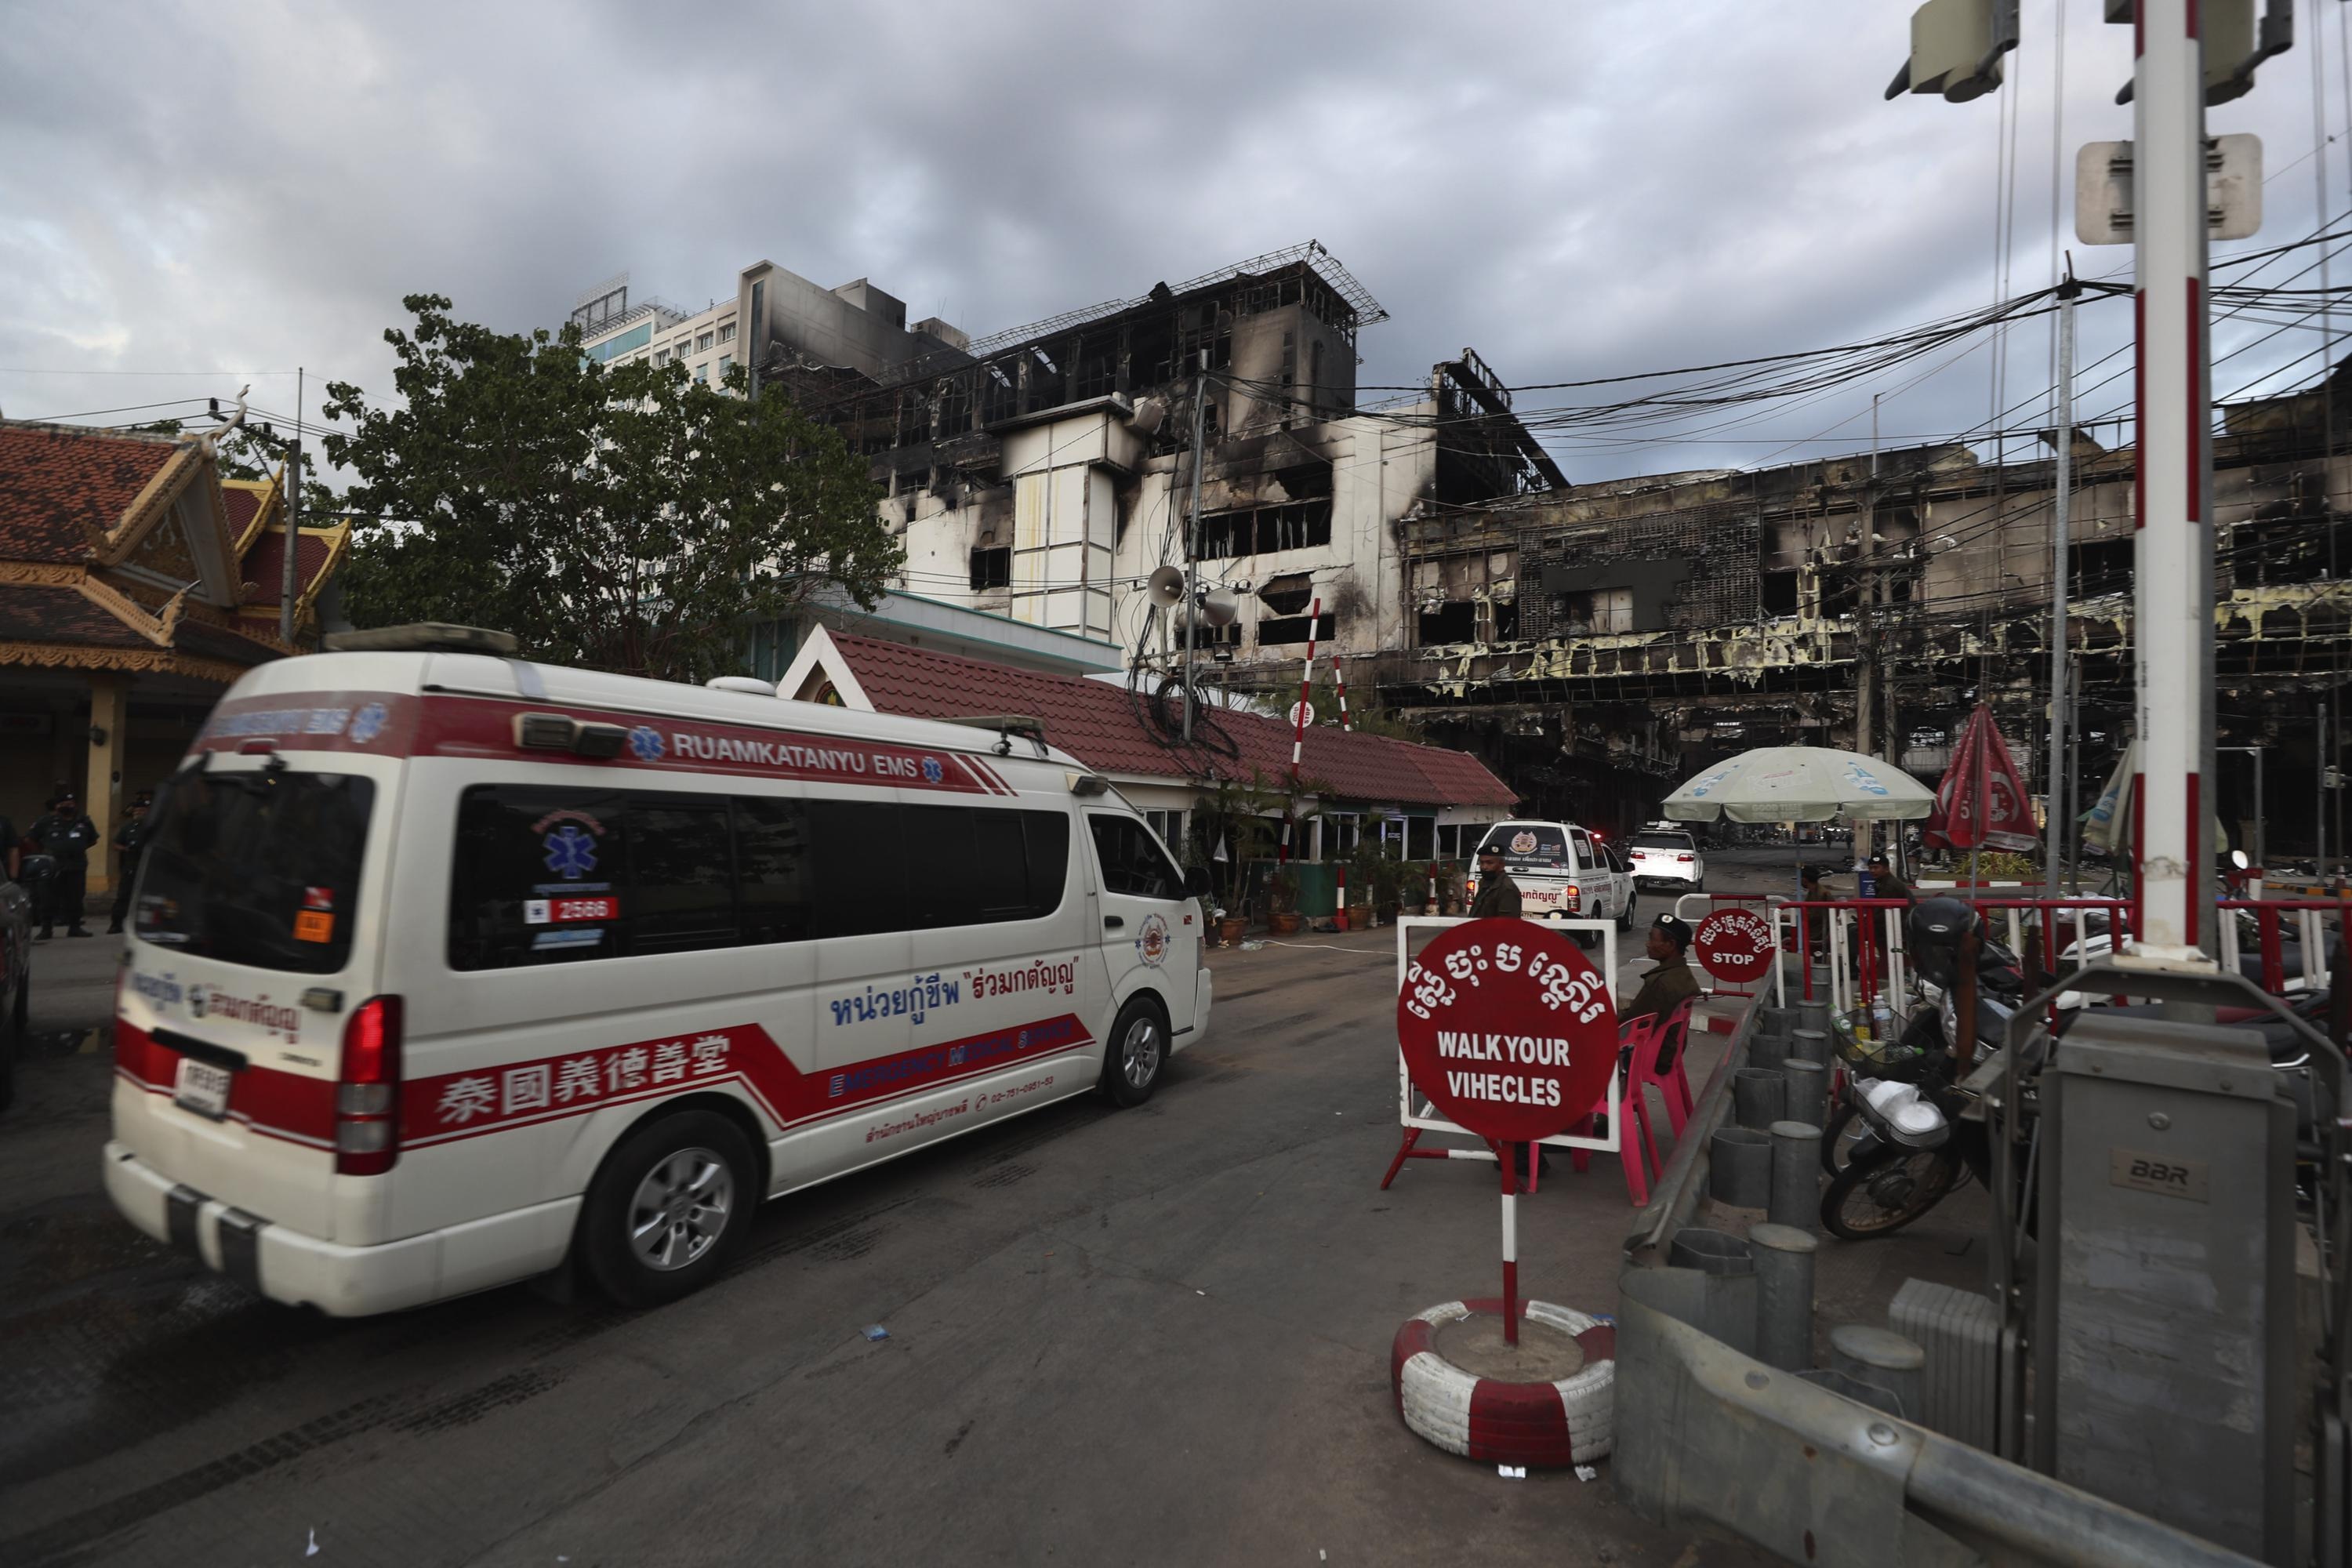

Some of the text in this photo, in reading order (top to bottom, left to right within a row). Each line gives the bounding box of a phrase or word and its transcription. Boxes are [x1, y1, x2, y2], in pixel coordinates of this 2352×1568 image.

[672, 733, 918, 777] RUAMKATANYU EMS
[1519, 889, 1558, 904] มกตัญญู
[1712, 953, 1755, 965] STOP
[830, 972, 960, 1026] หน่วยกู้ชีพ
[829, 1021, 1073, 1098] EMERGENCY MEDICAL SERVICE
[1437, 1031, 1571, 1067] WALK YOUR
[434, 1034, 731, 1124] 泰國義德善堂
[1446, 1070, 1562, 1107] VIHECLES
[2129, 1159, 2190, 1186] BBR
